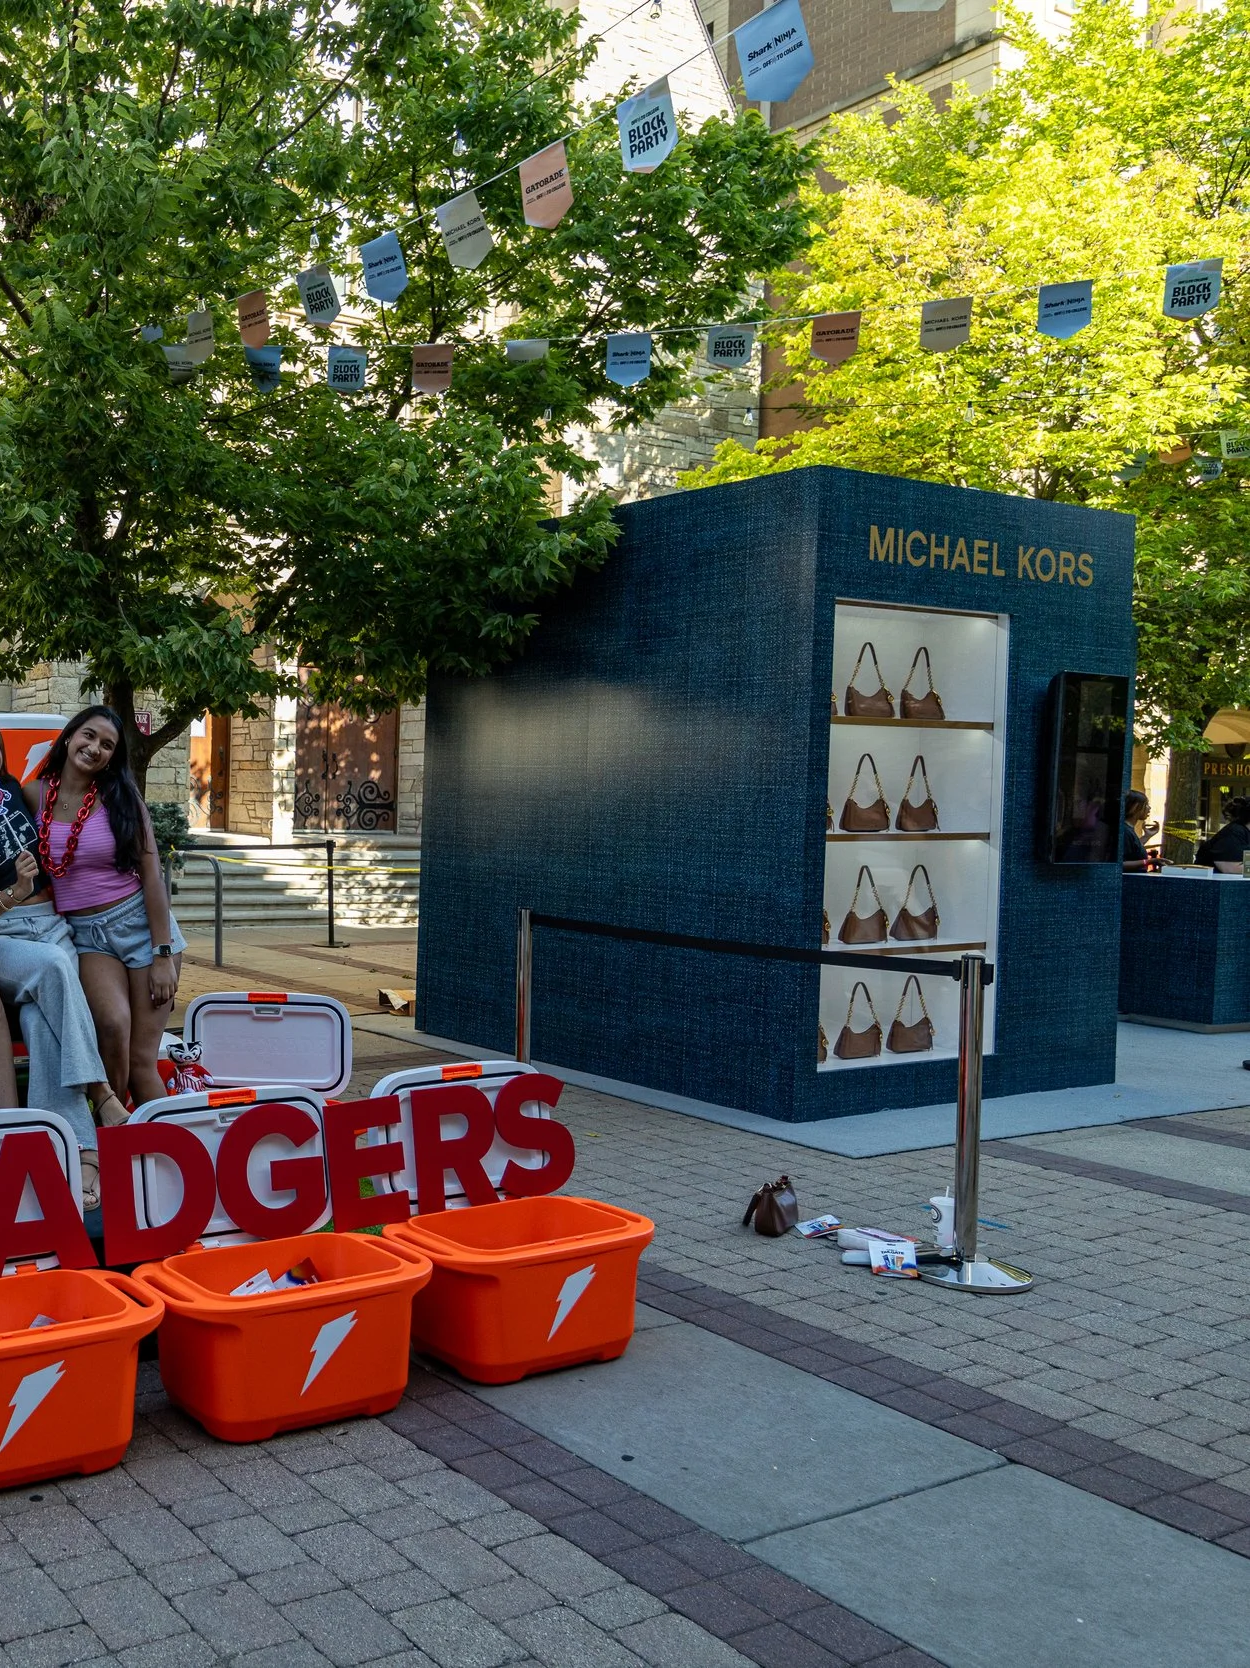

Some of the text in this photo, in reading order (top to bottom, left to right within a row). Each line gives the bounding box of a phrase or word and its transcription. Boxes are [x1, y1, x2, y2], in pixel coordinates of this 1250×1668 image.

[747, 42, 772, 61] Shark
[628, 111, 666, 144] BLOCK
[629, 126, 668, 159] PARTY
[525, 168, 565, 195] GATORADE
[306, 286, 331, 304] BLOCK
[1172, 282, 1212, 298] BLOCK
[308, 297, 334, 315] PARTY
[1170, 293, 1211, 309] PARTY
[924, 315, 968, 326] MICHAEL KORS
[815, 327, 855, 337] GATORADE
[714, 339, 746, 349] BLOCK
[713, 348, 745, 358] PARTY
[333, 364, 360, 374] BLOCK
[415, 361, 449, 369] GATORADE
[332, 373, 360, 383] PARTY
[868, 524, 1094, 588] MICHAEL KORS
[1204, 762, 1233, 776] PRES
